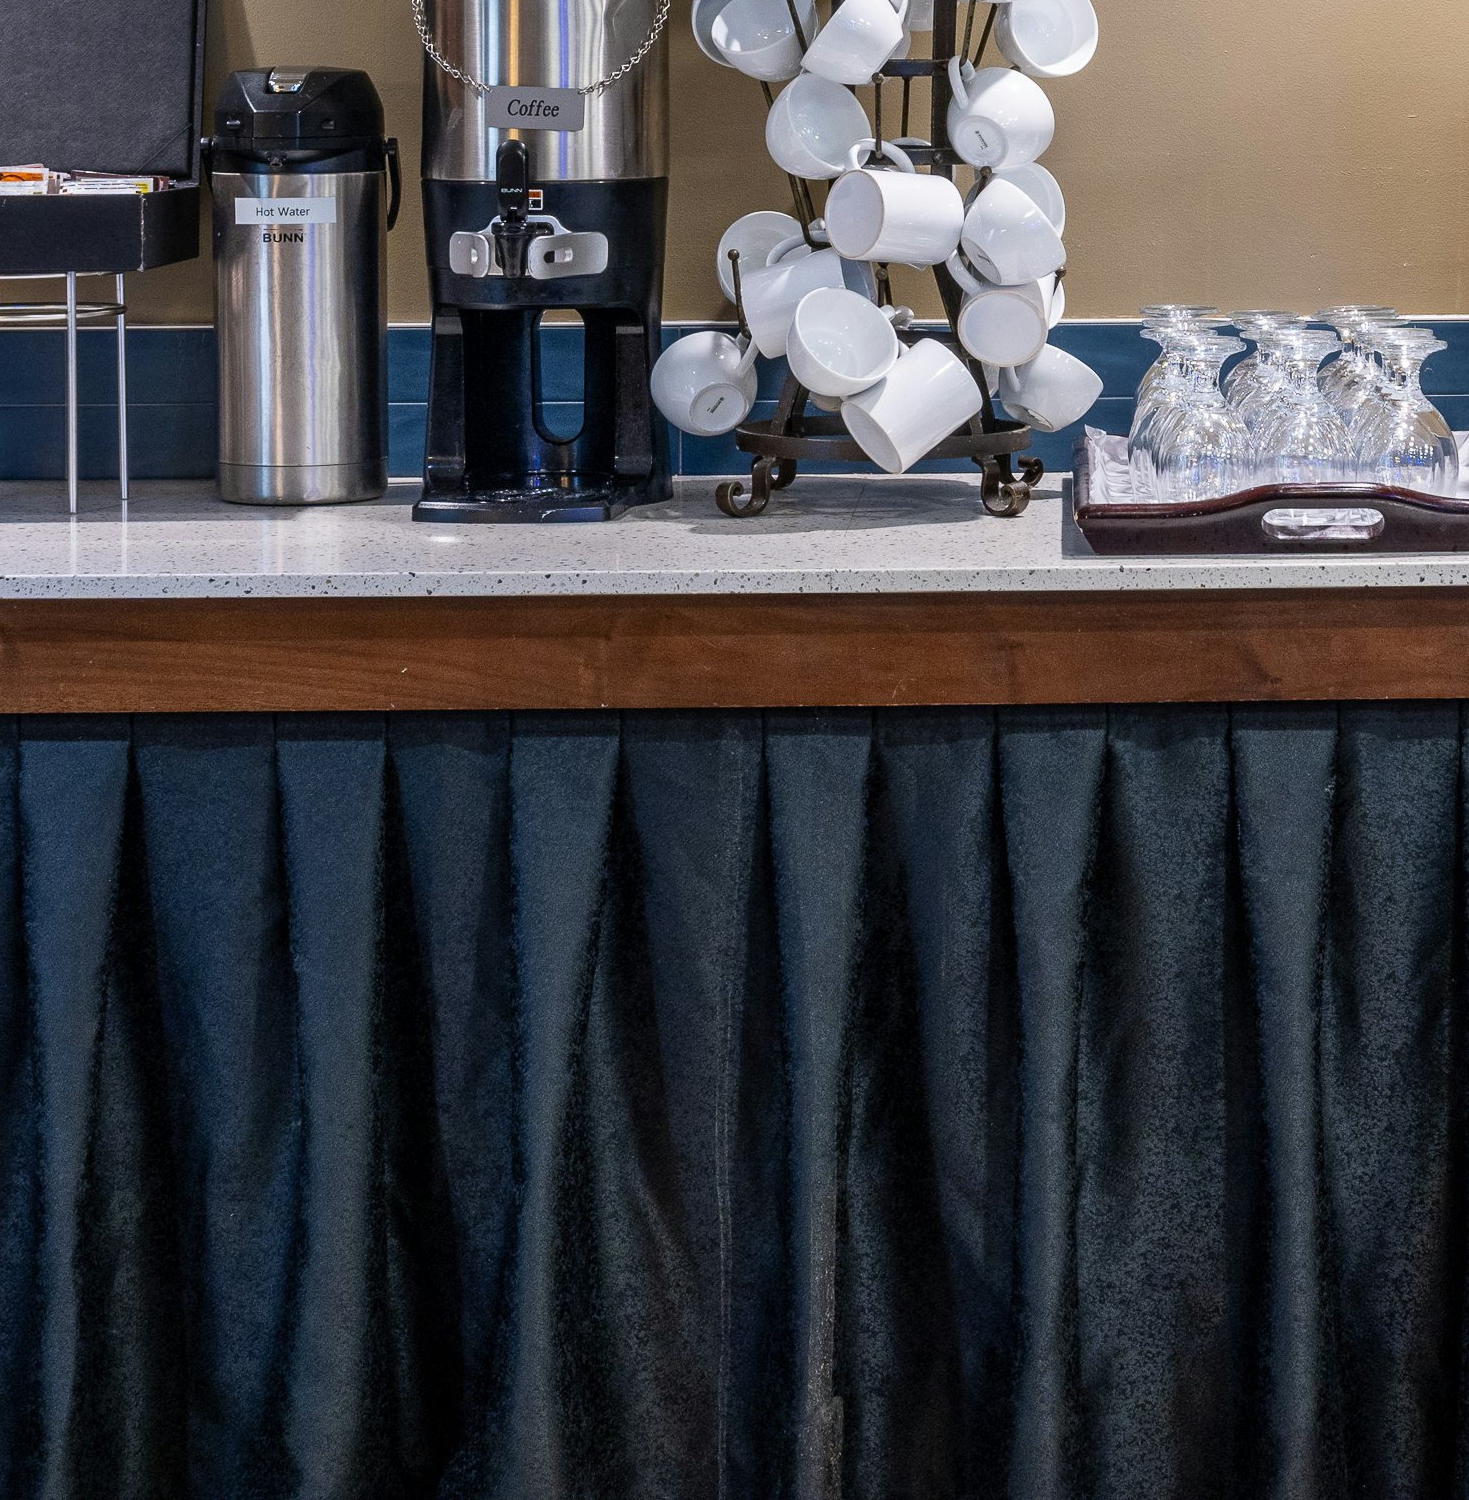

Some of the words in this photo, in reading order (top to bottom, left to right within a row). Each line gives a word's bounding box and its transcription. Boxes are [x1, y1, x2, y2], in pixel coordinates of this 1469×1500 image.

[507, 98, 560, 117] Coffee
[256, 206, 274, 217] Hot
[277, 206, 311, 217] Water
[262, 232, 304, 243] BUNN
